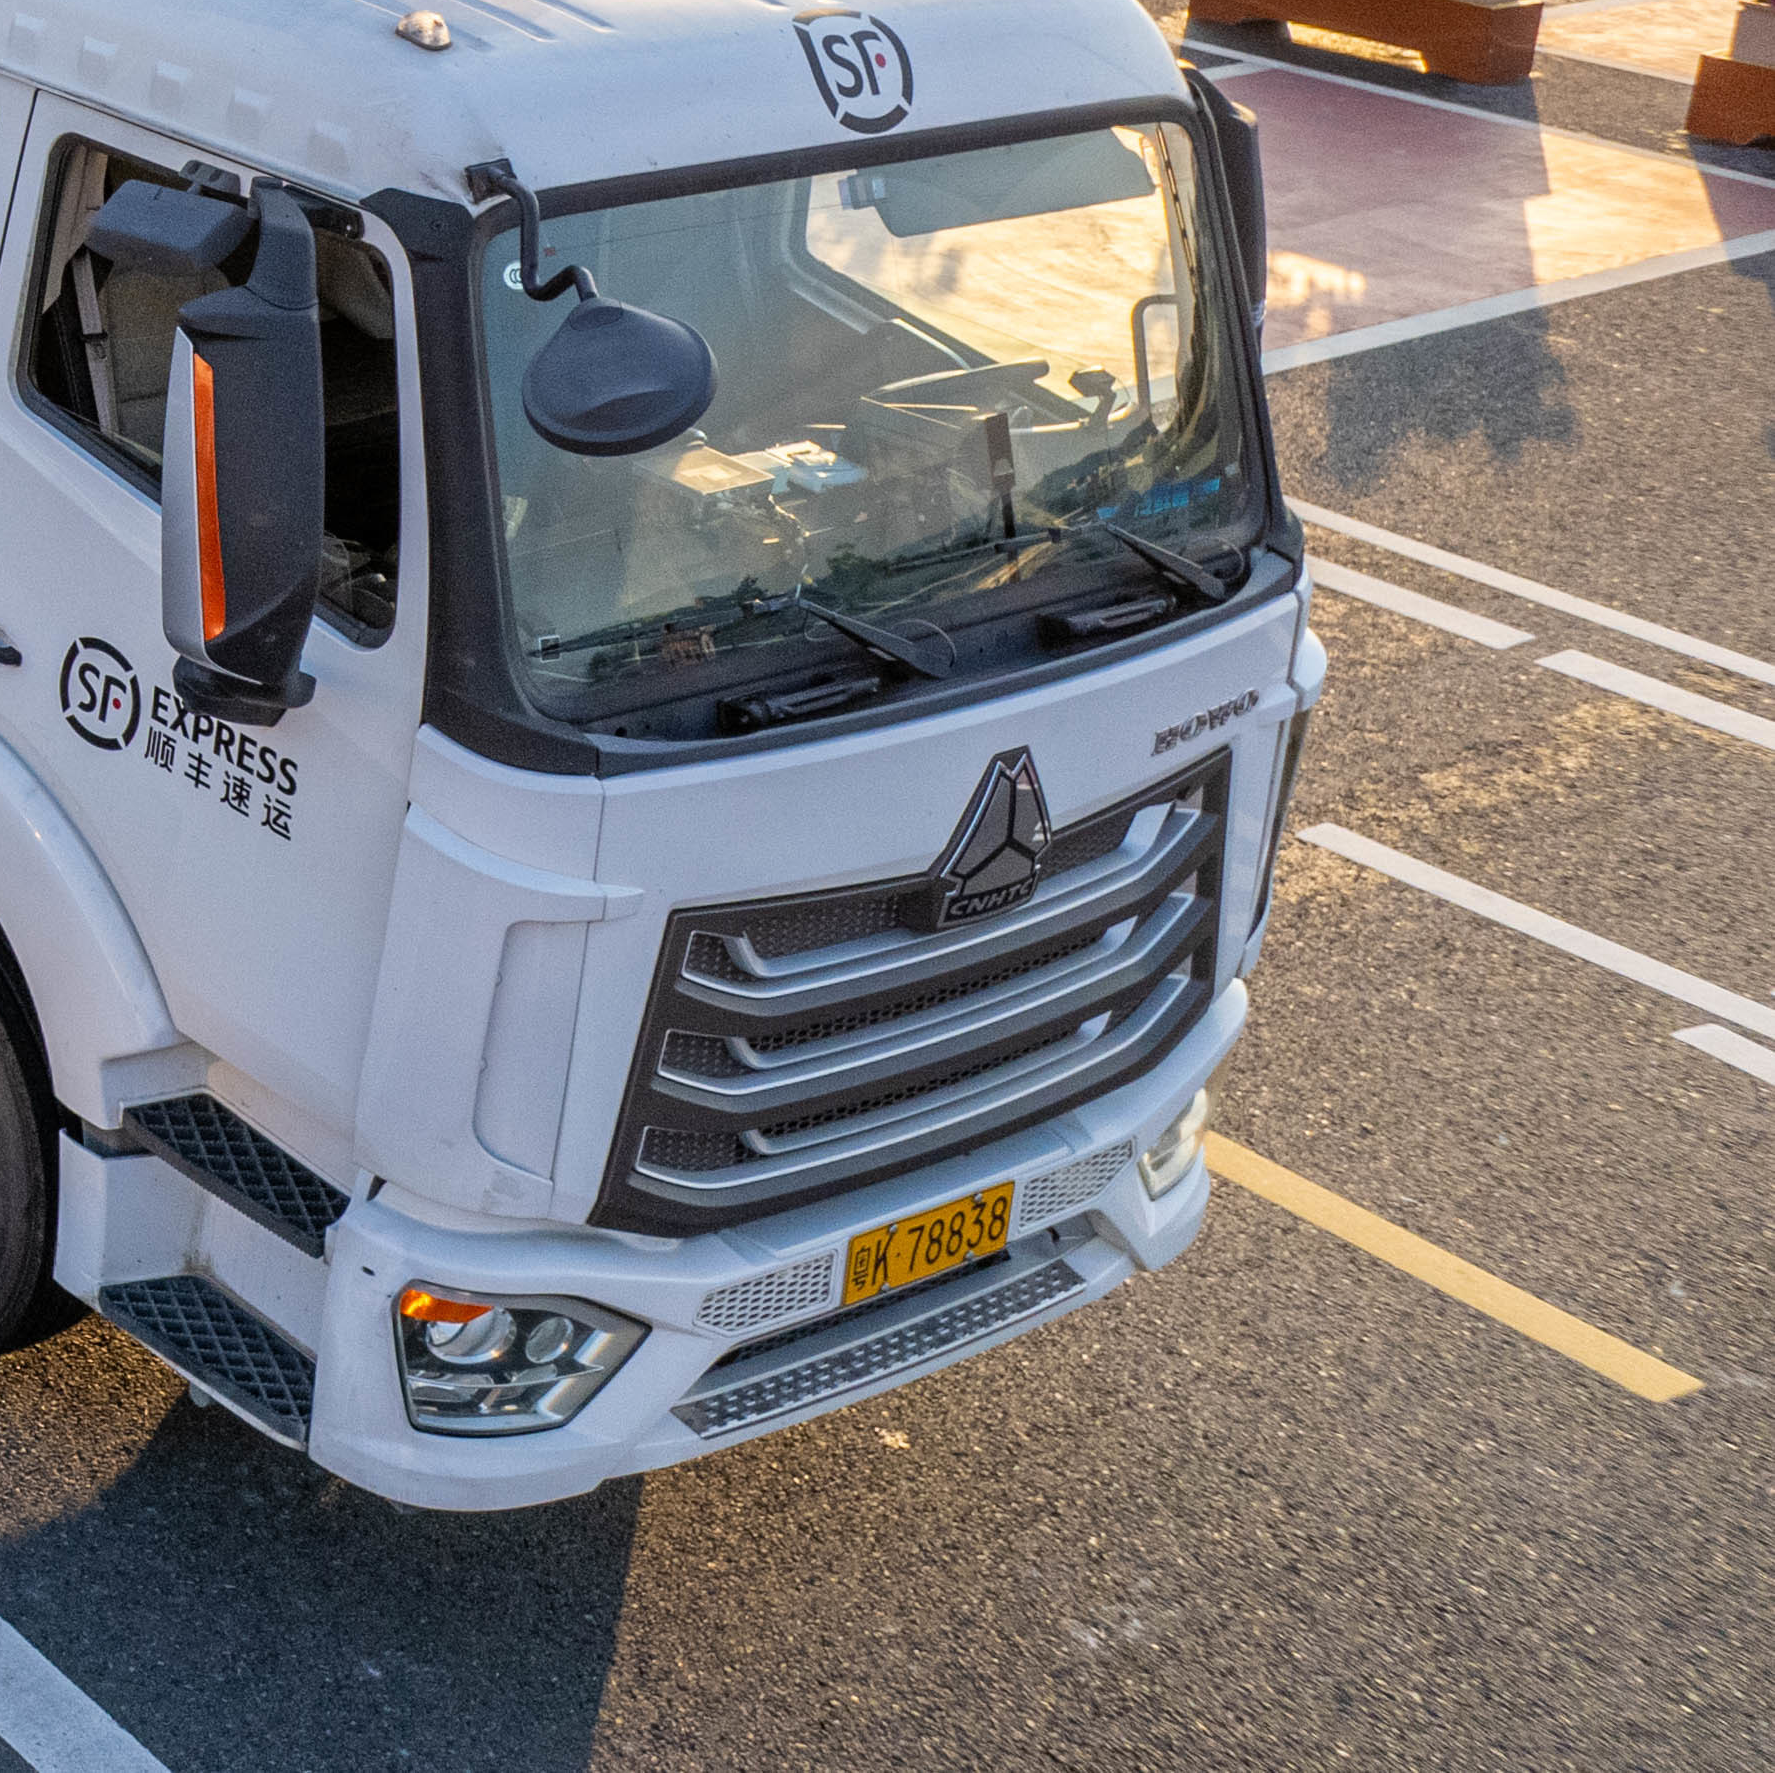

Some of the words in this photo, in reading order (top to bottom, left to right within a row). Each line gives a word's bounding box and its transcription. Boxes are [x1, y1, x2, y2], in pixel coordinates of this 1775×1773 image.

[144, 725, 292, 841] 顺丰速运
[151, 685, 299, 797] EXPRESS
[950, 880, 1032, 917] CNHTC
